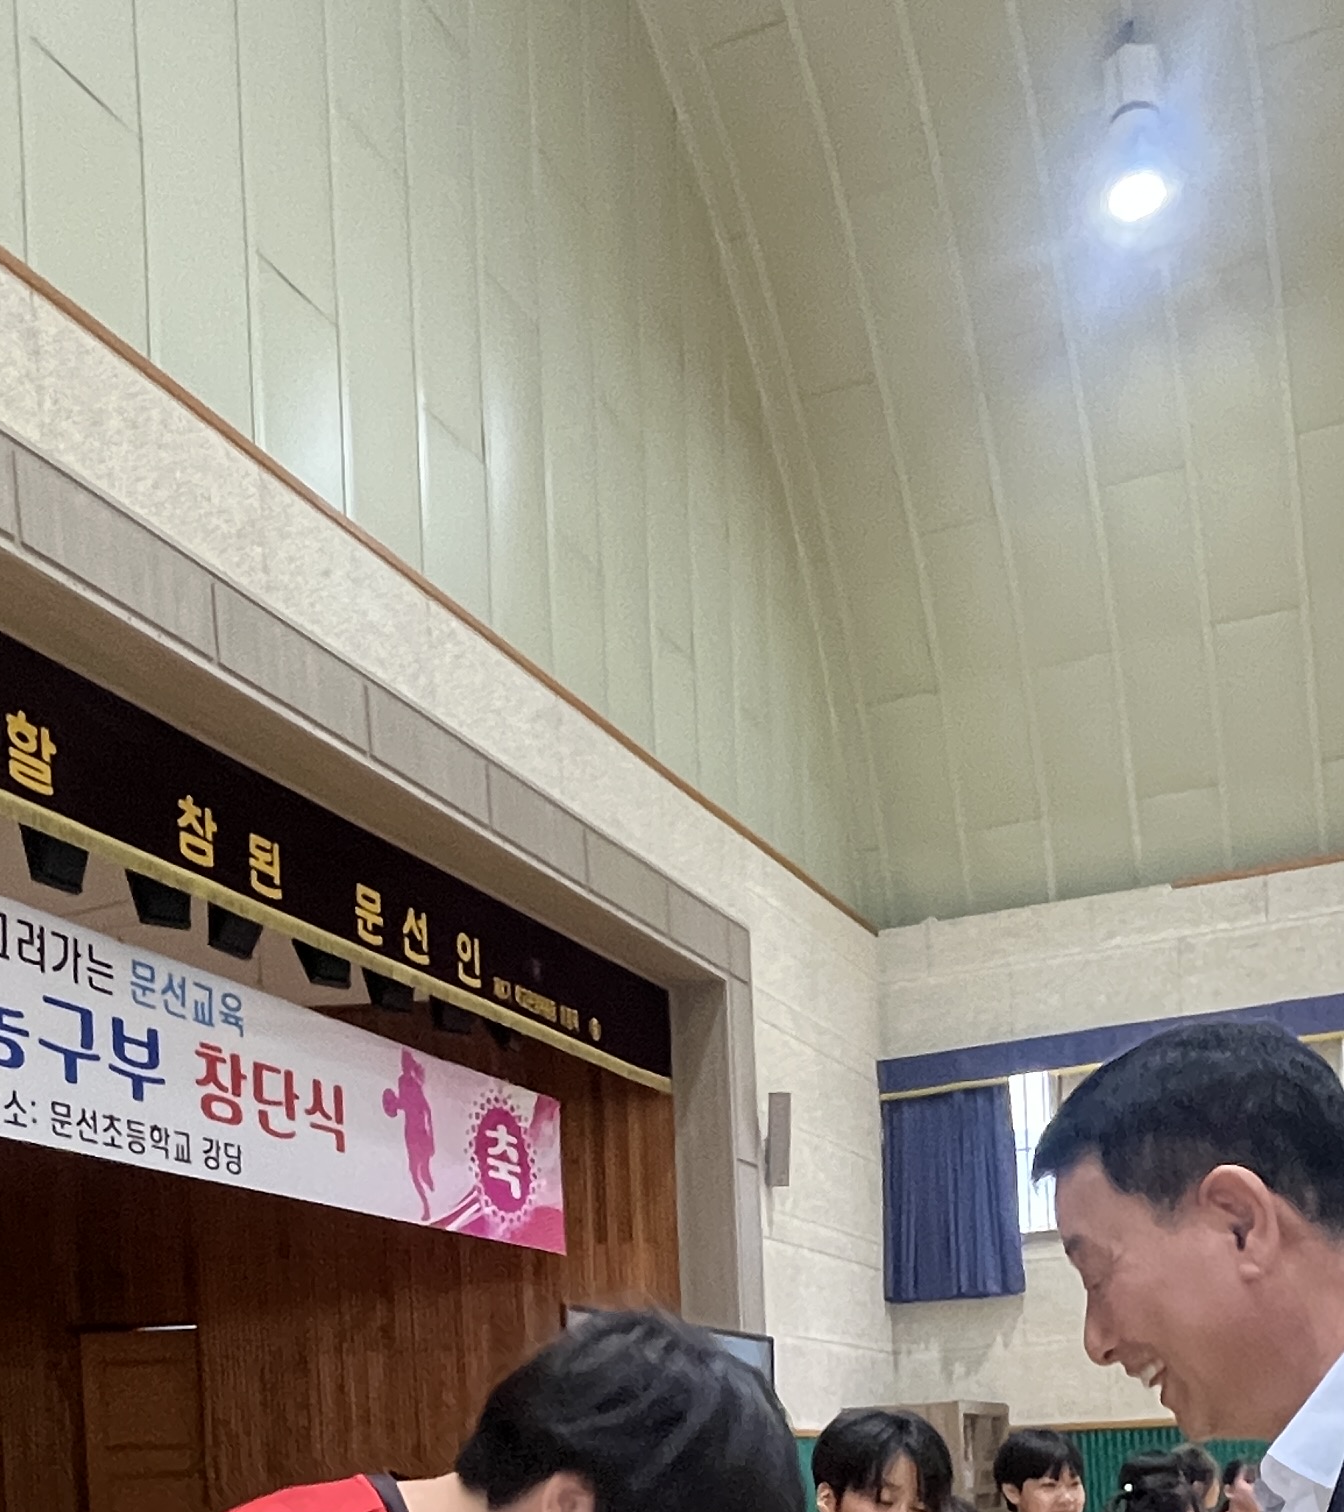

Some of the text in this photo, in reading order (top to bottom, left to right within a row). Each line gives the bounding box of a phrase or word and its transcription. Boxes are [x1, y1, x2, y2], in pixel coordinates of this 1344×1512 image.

[177, 795, 282, 899] 참된
[354, 883, 481, 989] 문선인
[130, 958, 244, 1037] 문선교육
[195, 1042, 346, 1153] 창단식
[50, 1100, 192, 1164] 문선초등학교
[203, 1137, 244, 1175] 강당
[485, 1124, 521, 1199] 축
